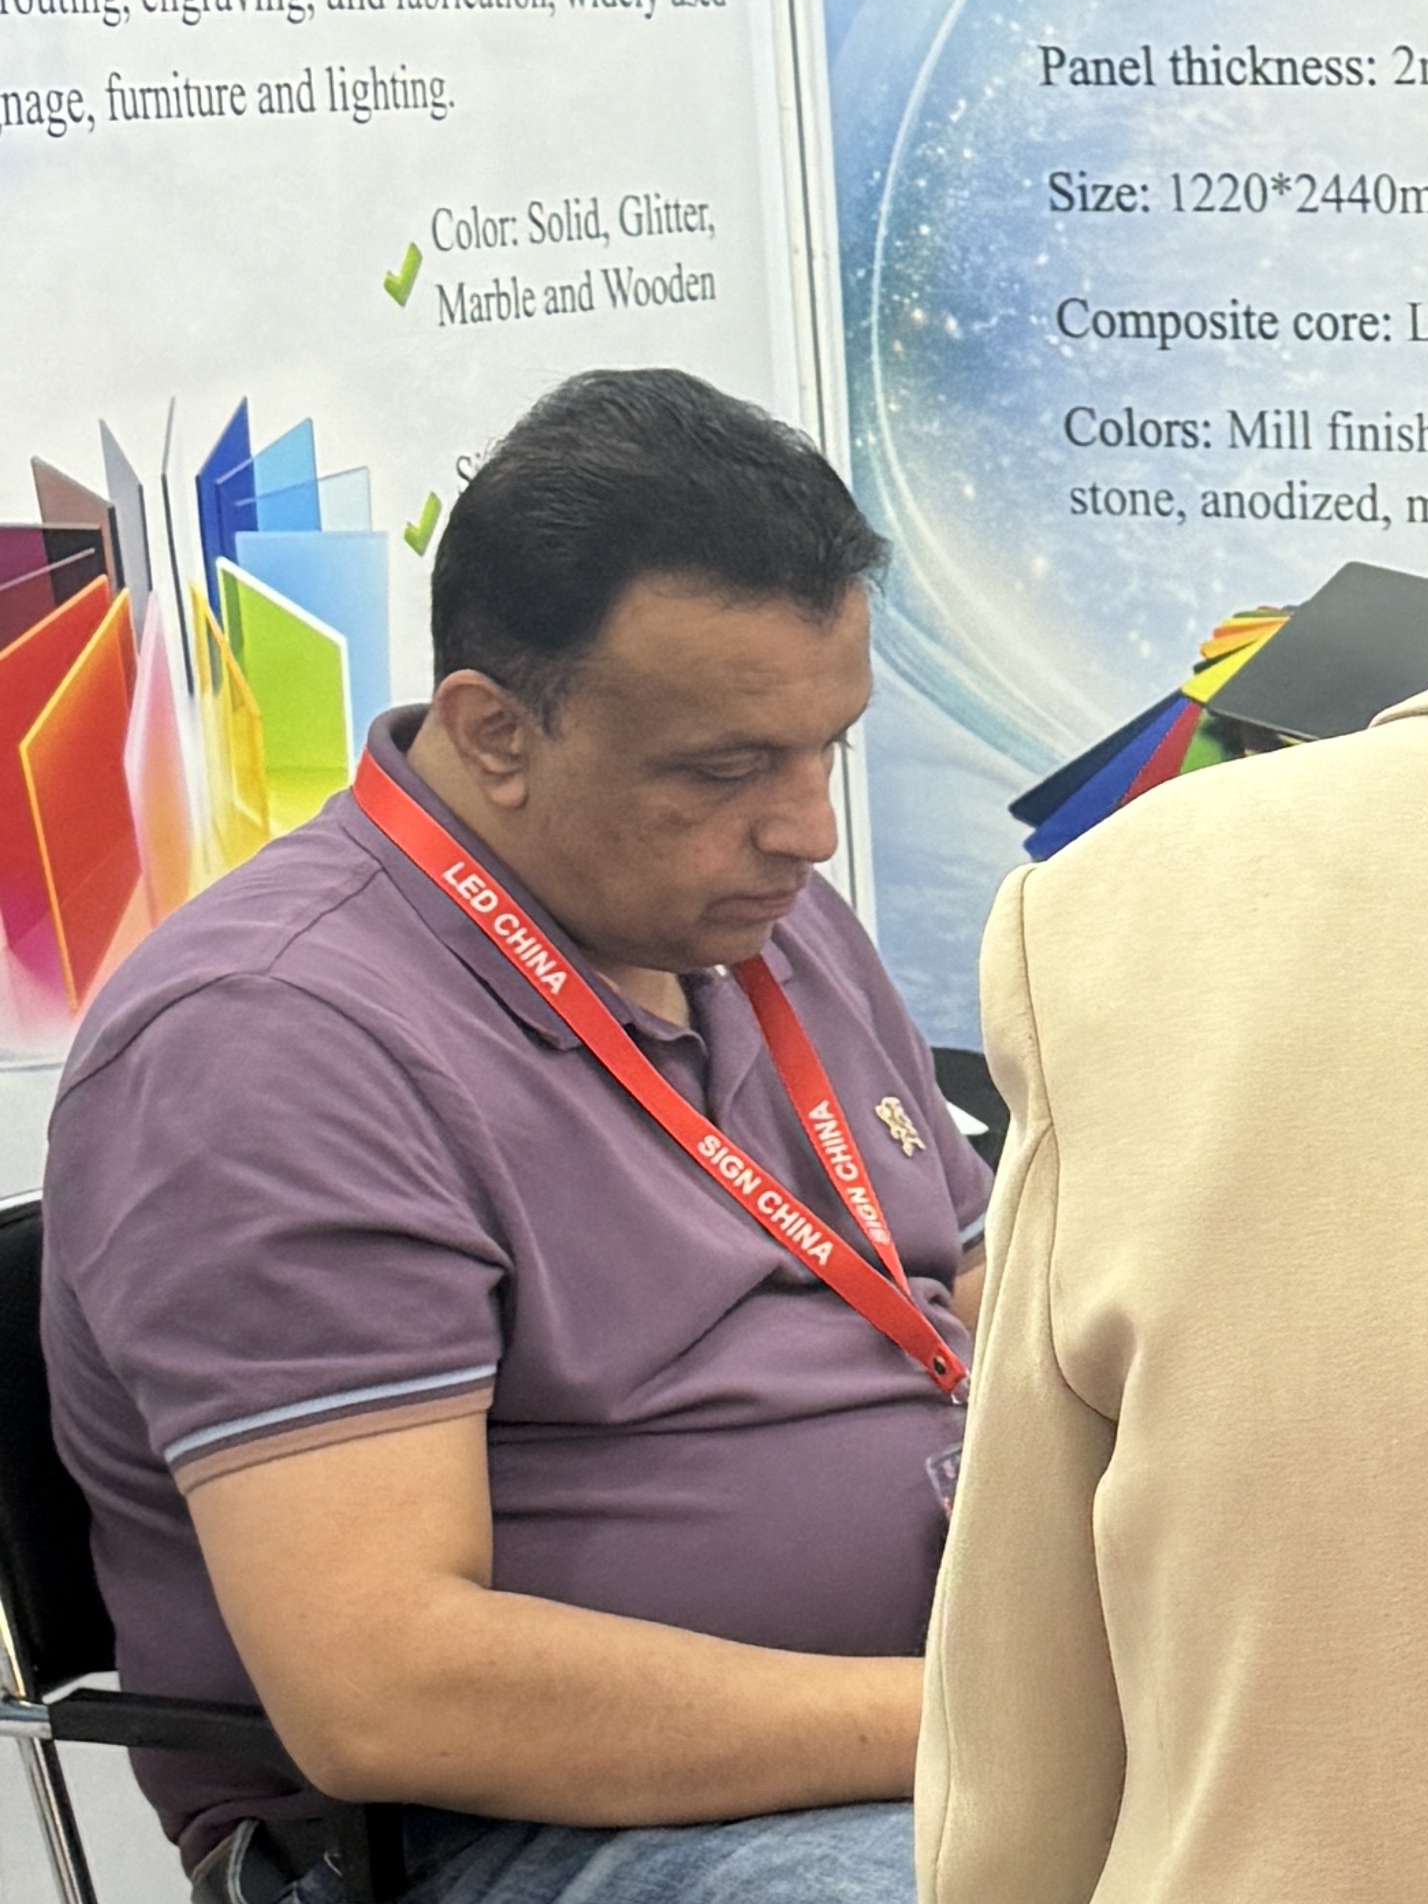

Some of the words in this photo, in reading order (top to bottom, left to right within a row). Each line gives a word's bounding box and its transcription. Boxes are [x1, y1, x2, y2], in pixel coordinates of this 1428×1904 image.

[105, 70, 247, 122] furniture
[256, 66, 317, 115] and
[324, 63, 455, 125] lighting.
[1036, 44, 1156, 87] Panel
[1168, 43, 1377, 87] thickness:
[1048, 170, 1150, 213] Size:
[431, 204, 519, 253] Color:
[527, 196, 611, 248] Solid,
[618, 192, 715, 238] Glitter,
[435, 275, 536, 327] Marble
[543, 268, 595, 316] and
[599, 261, 717, 309] Wooden
[1056, 297, 1280, 352] Composite
[1292, 311, 1392, 343] core:
[1063, 406, 1212, 450] Colors:
[1227, 408, 1312, 451] Mill
[1069, 482, 1187, 526] stone,
[1200, 479, 1392, 531] anodized,
[442, 861, 499, 914] LED
[493, 912, 569, 995] CHINA
[808, 1100, 859, 1181] CHINA
[697, 1133, 761, 1195] SIGN
[756, 1190, 836, 1267] CHINA
